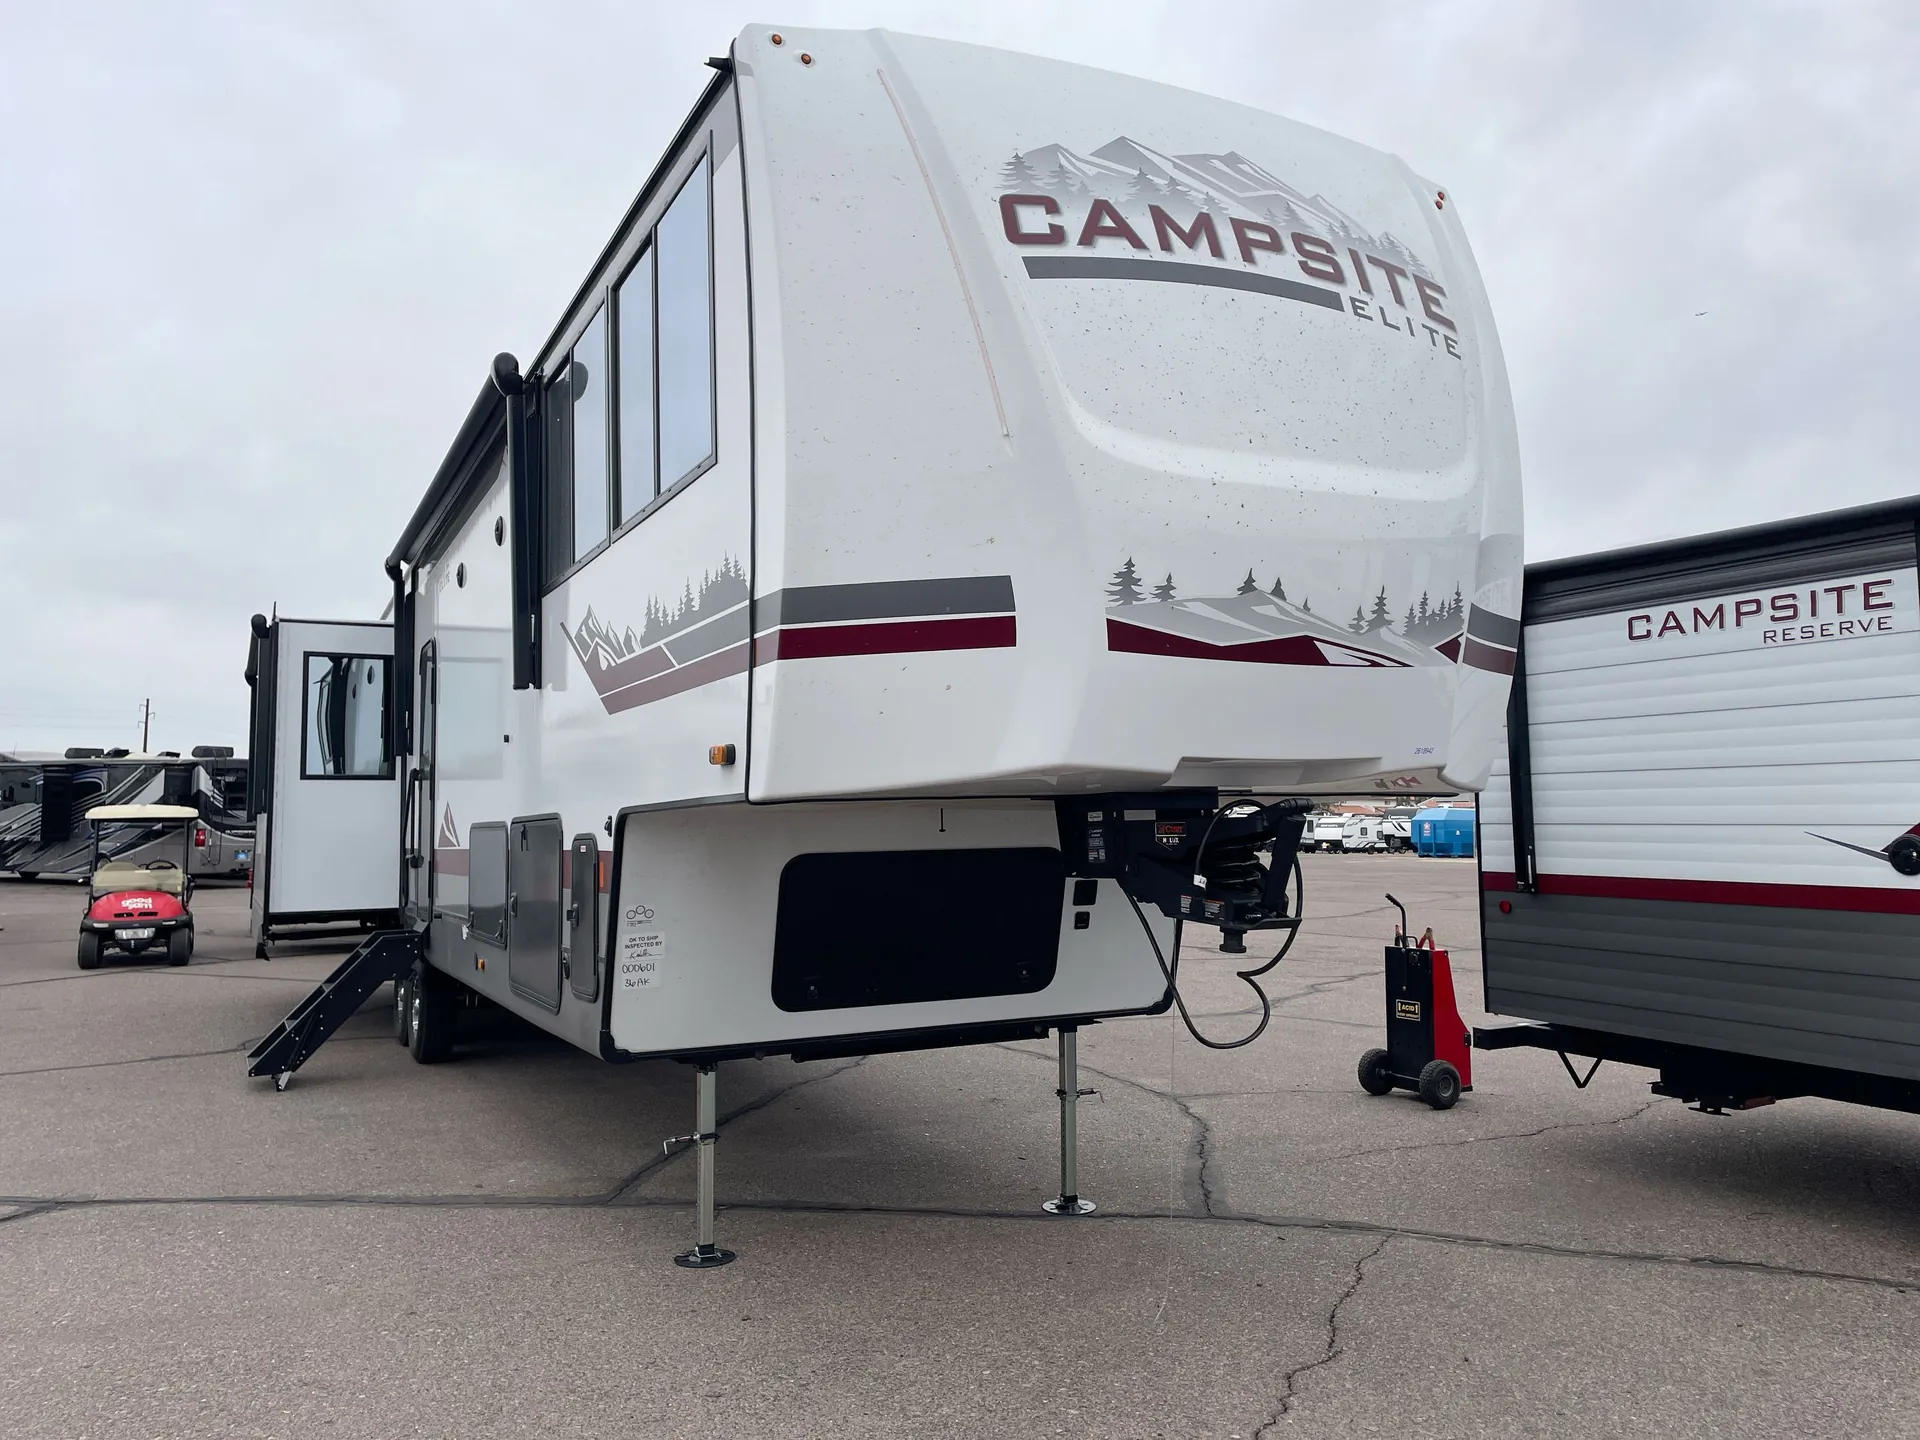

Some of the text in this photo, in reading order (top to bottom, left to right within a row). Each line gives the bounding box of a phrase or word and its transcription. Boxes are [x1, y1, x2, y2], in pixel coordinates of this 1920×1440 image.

[998, 192, 1457, 332] CAMPSITE
[1348, 295, 1462, 361] ELITE
[1627, 578, 1895, 642] CAMPSITE
[1762, 615, 1894, 644] RESERVE
[121, 897, 152, 907] good
[621, 962, 655, 974] 000601
